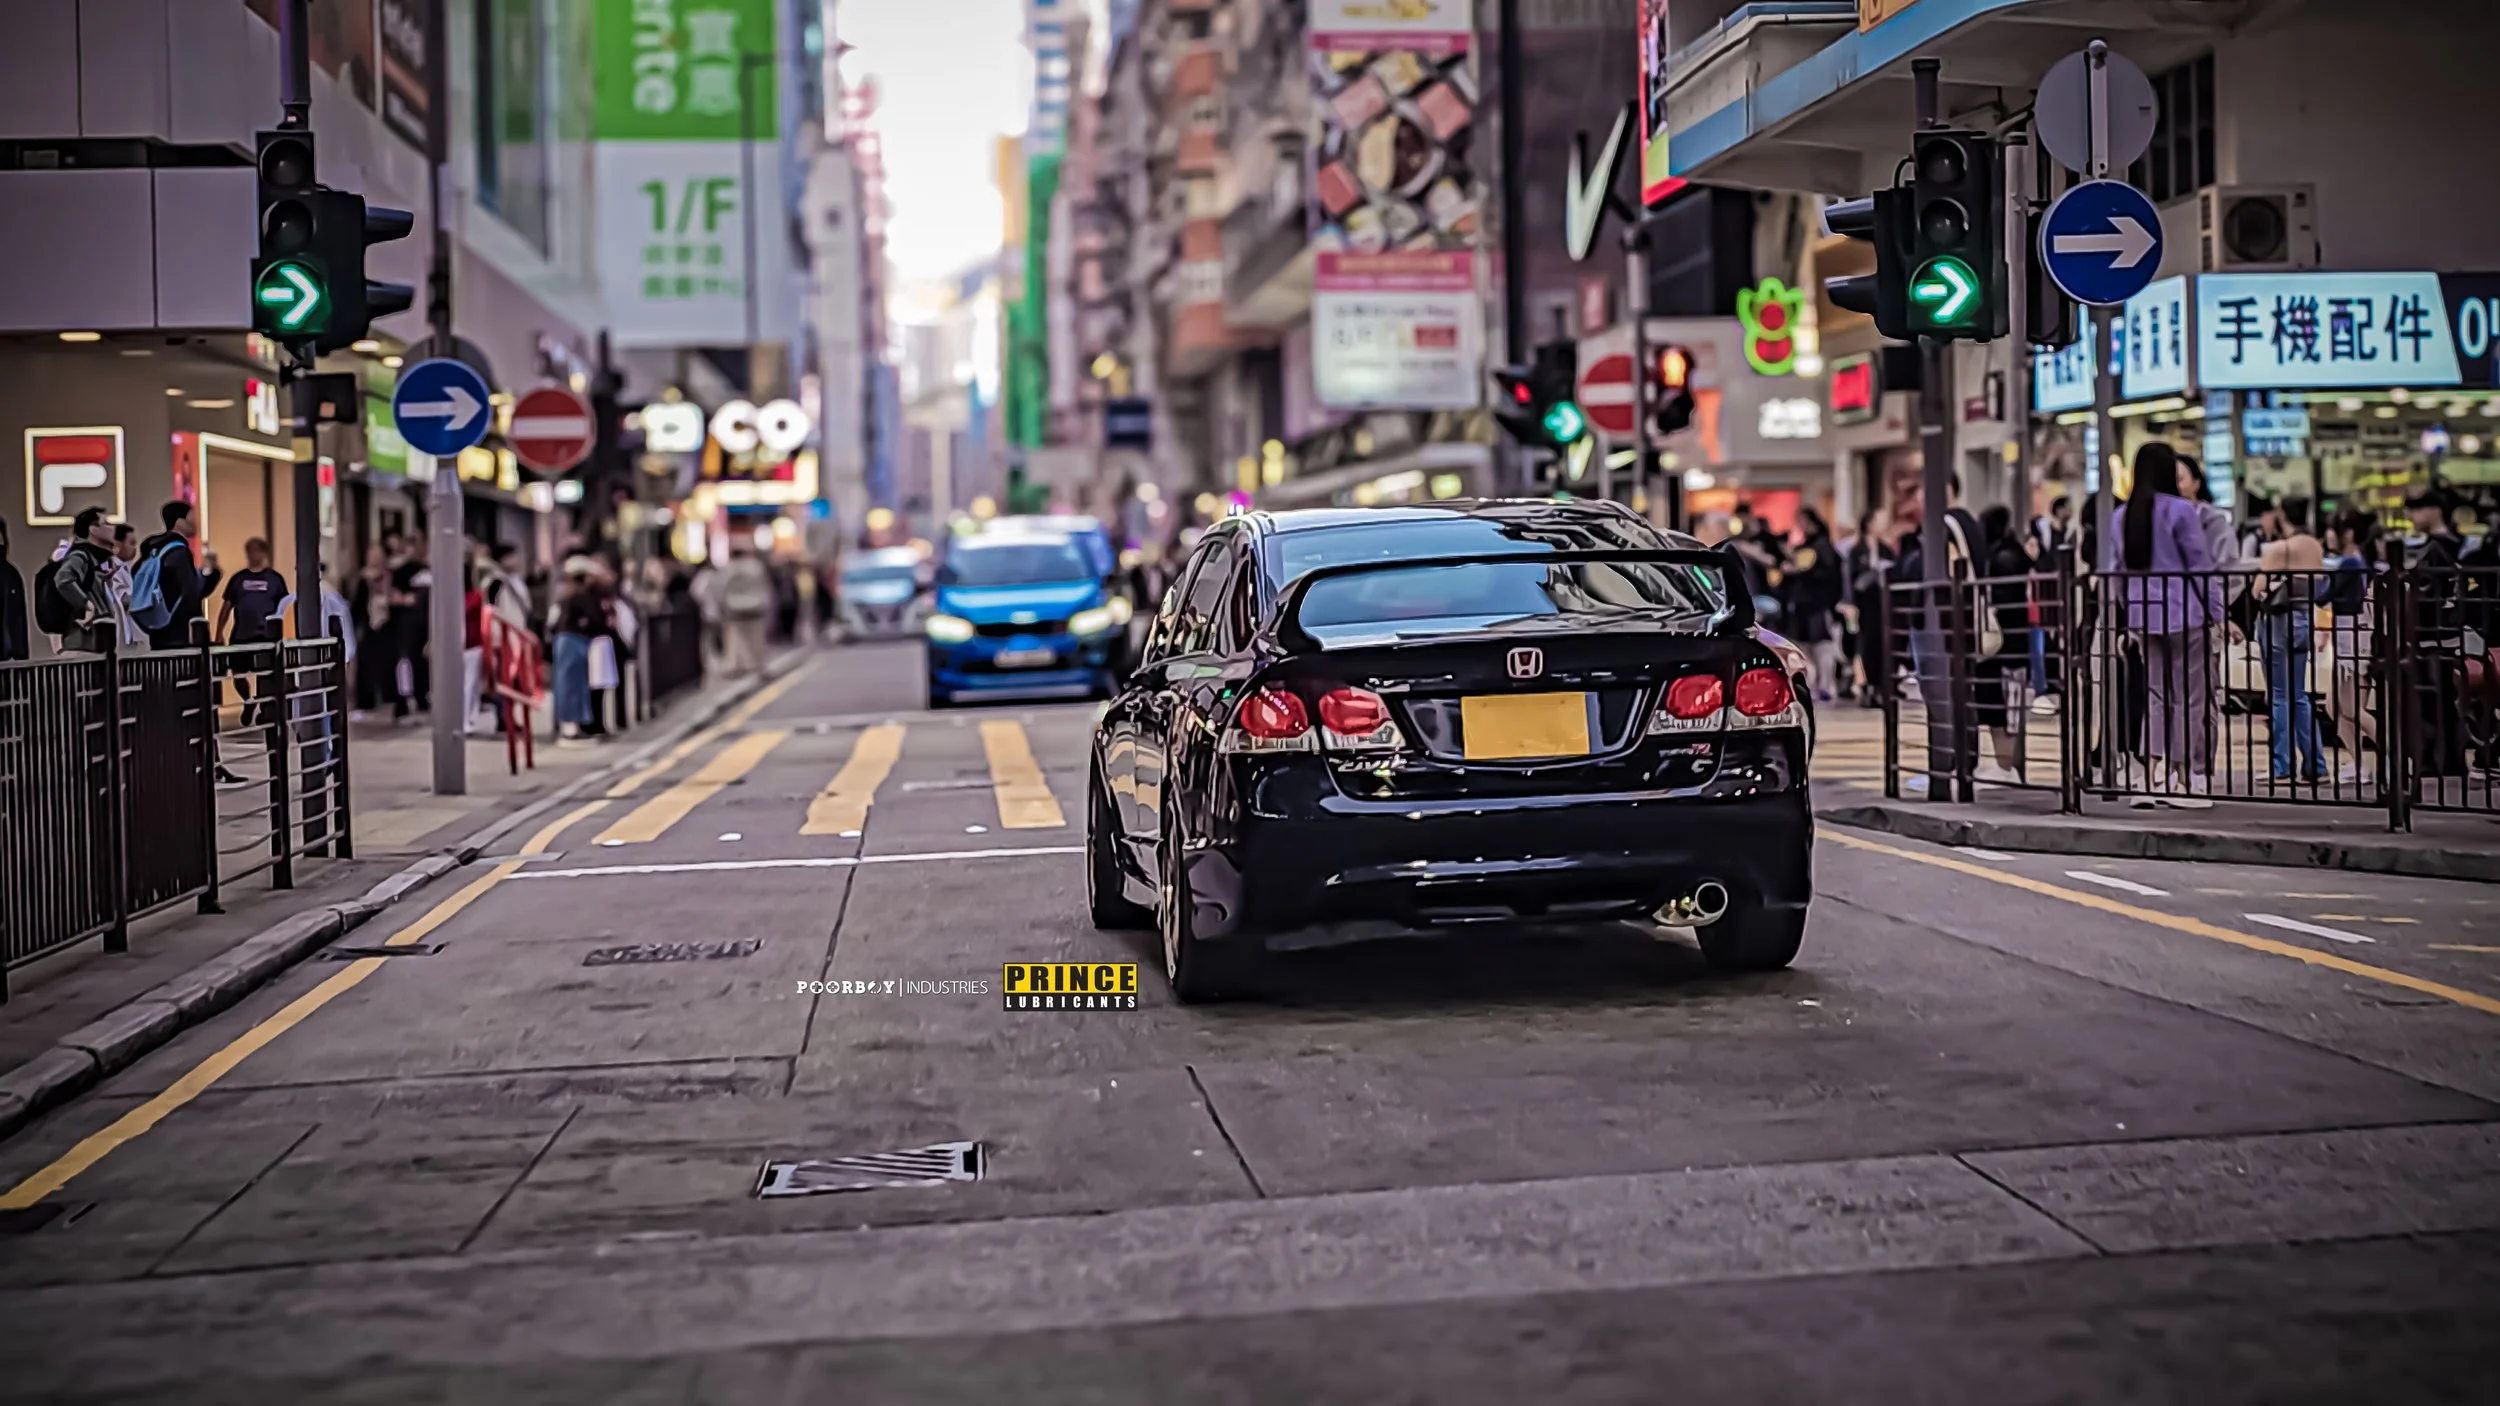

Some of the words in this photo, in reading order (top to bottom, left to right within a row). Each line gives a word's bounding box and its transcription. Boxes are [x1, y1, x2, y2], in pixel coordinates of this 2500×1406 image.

[639, 176, 736, 234] 1/F
[2214, 294, 2435, 364] 手機配件
